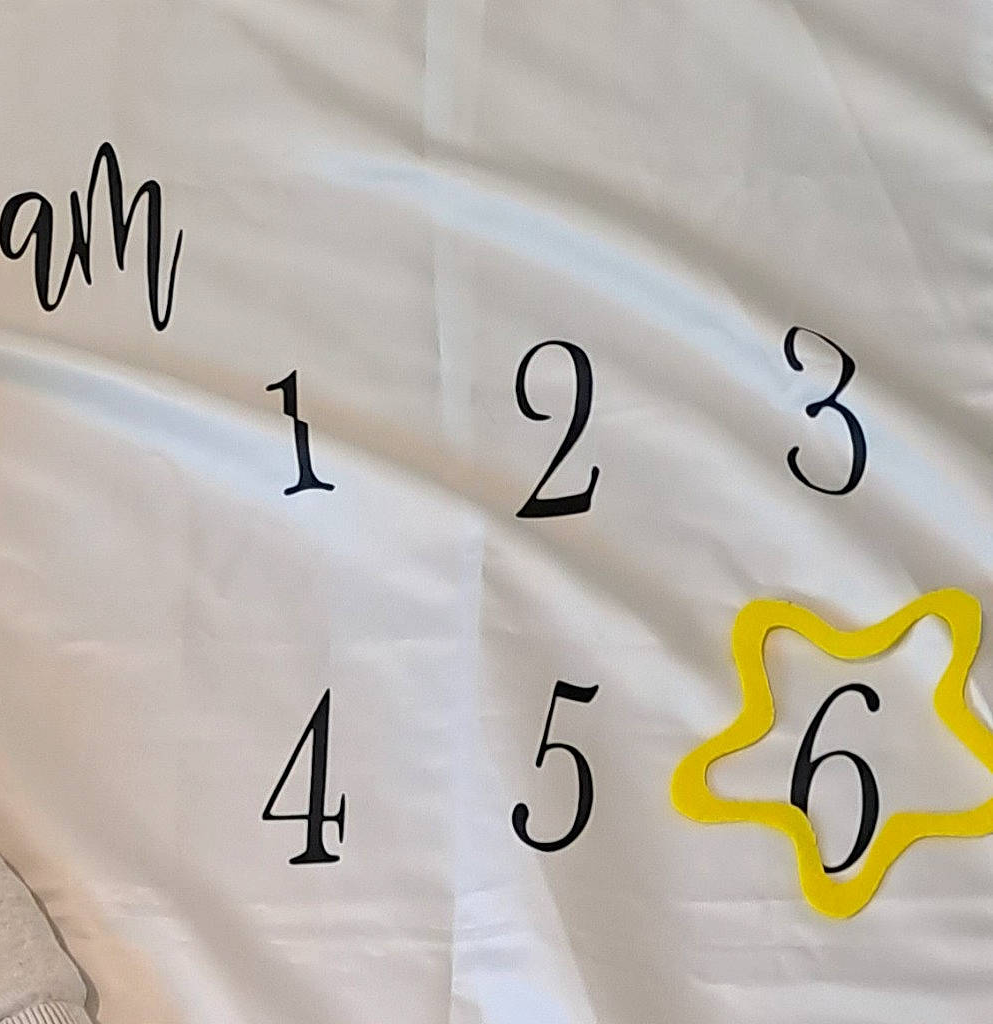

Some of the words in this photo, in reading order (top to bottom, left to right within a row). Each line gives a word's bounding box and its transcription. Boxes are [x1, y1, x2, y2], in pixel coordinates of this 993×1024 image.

[265, 369, 335, 496] 1
[515, 340, 601, 519] 2
[783, 326, 867, 496] 3
[262, 688, 347, 865] 4
[511, 679, 600, 853] 5
[790, 683, 881, 874] 6
